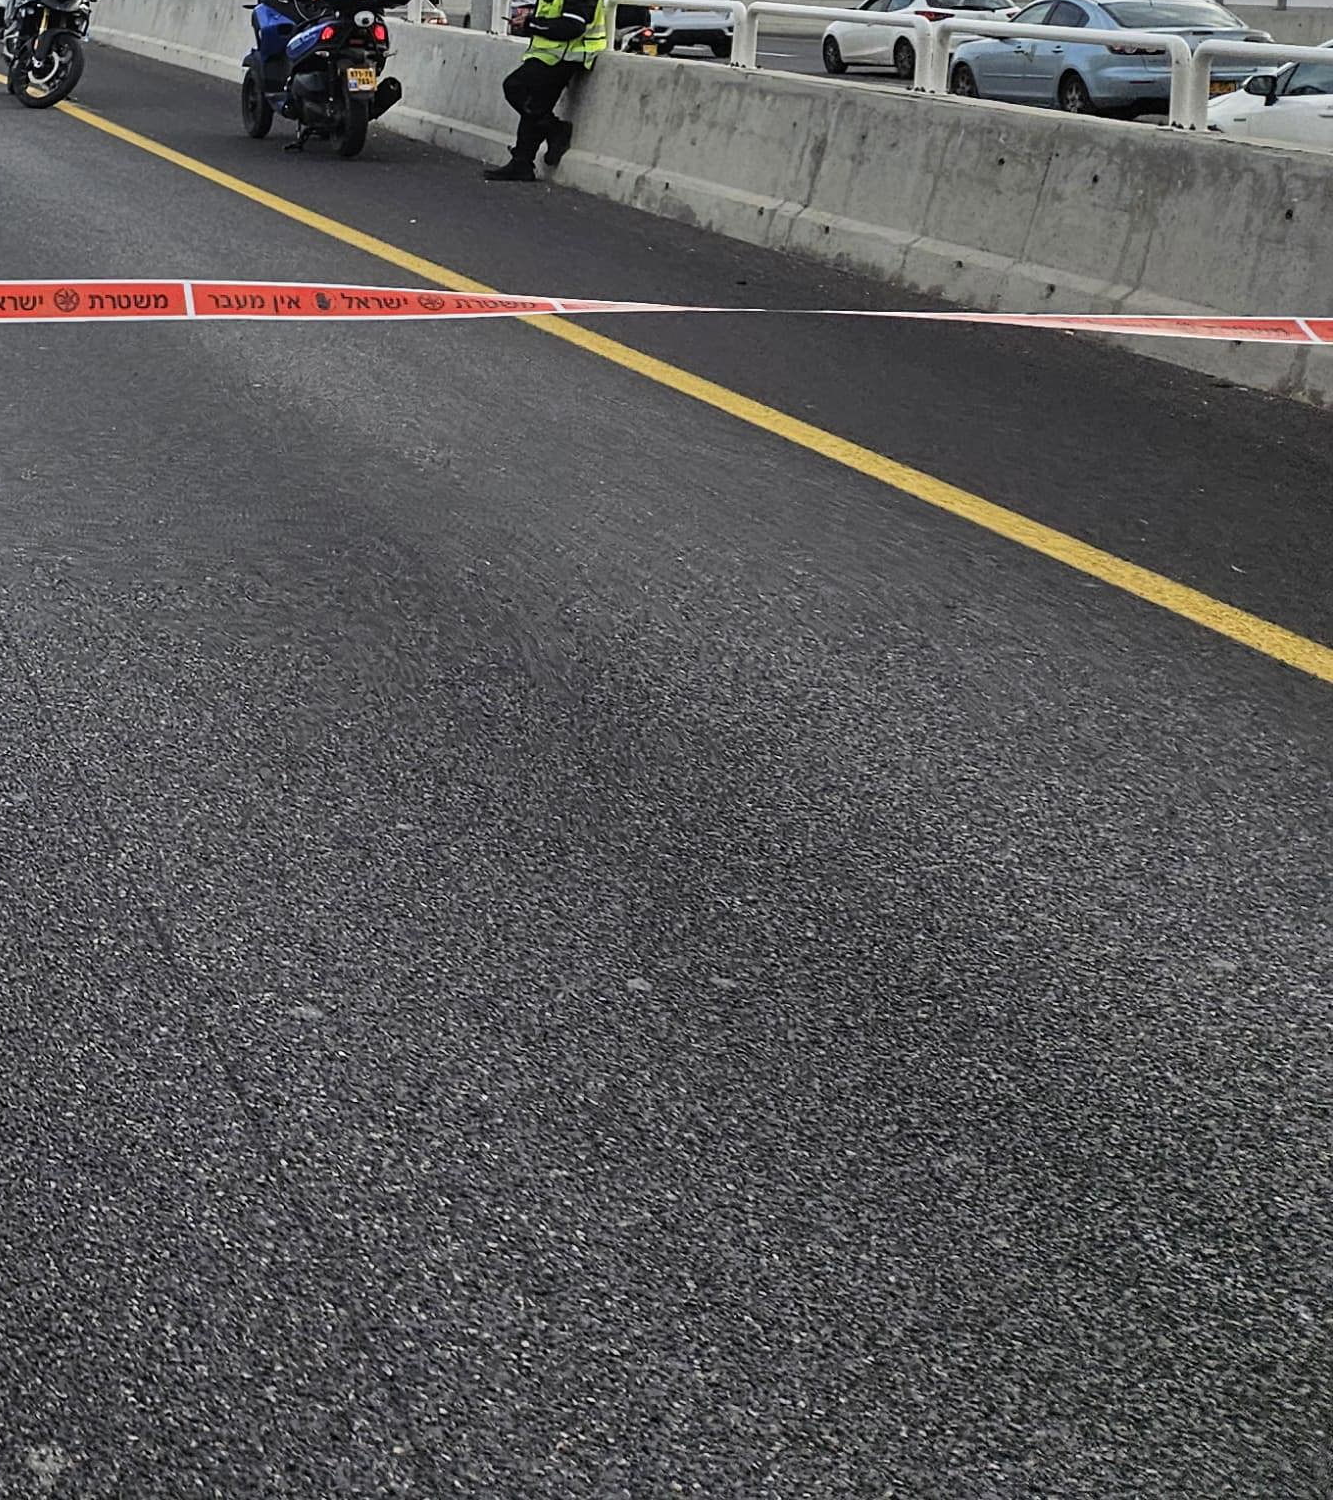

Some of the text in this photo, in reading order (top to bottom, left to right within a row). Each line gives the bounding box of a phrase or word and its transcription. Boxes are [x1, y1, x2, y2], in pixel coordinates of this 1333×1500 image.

[89, 294, 168, 309] משטרת
[208, 295, 265, 310] מעבר
[273, 296, 301, 315] אין
[341, 293, 408, 309] ישראל
